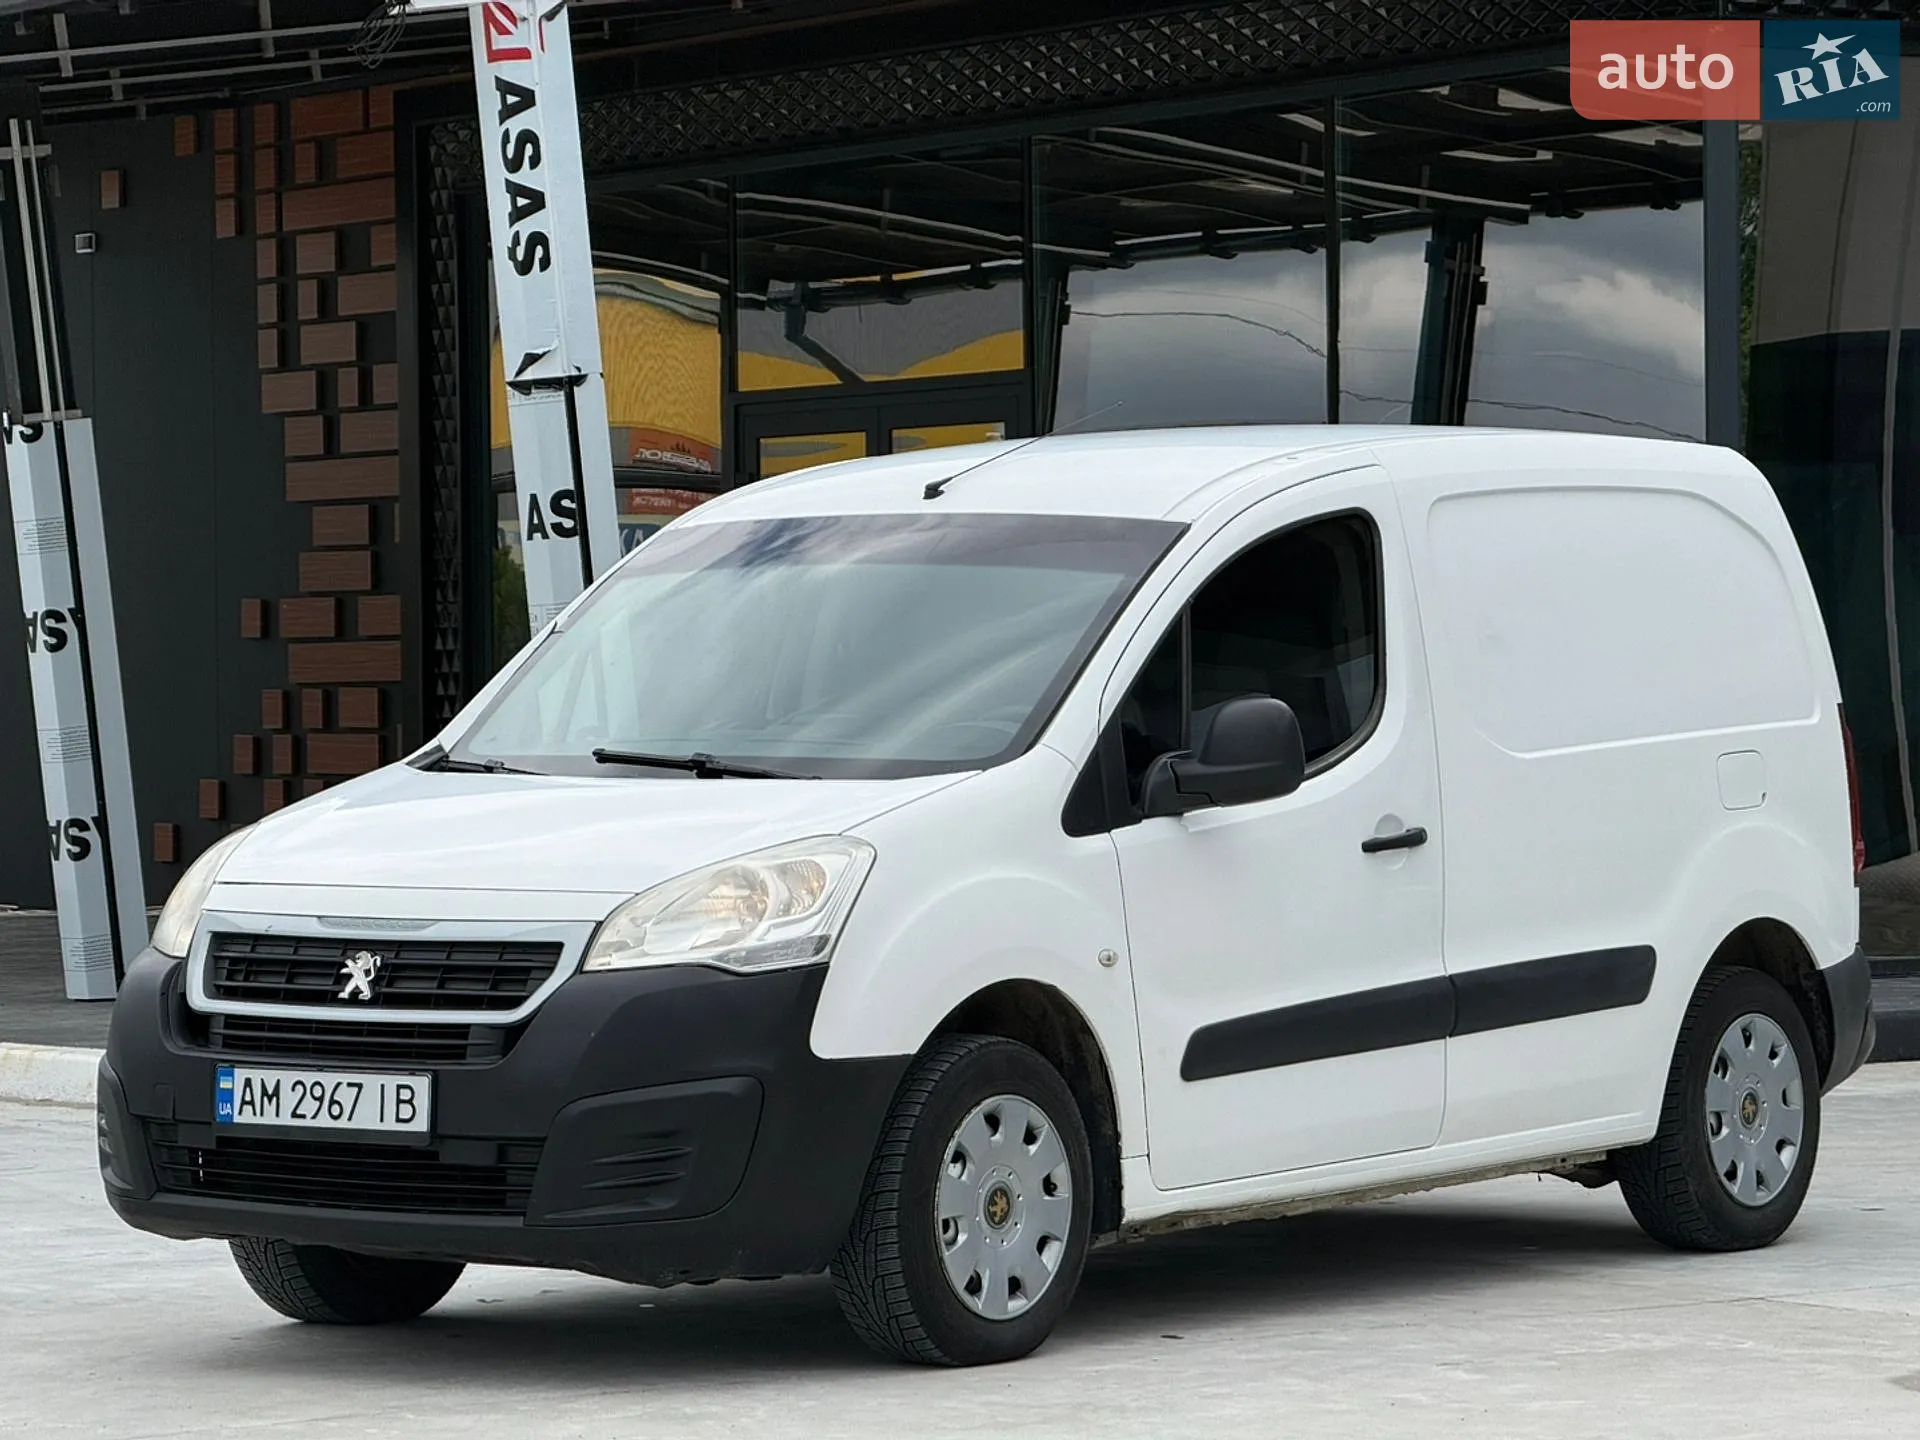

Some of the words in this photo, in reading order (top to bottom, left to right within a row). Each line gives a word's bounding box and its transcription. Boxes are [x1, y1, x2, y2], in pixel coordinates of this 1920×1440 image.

[219, 1102, 232, 1115] UA
[238, 1077, 281, 1118] AM
[290, 1079, 364, 1121] 2967
[379, 1083, 422, 1124] IB
